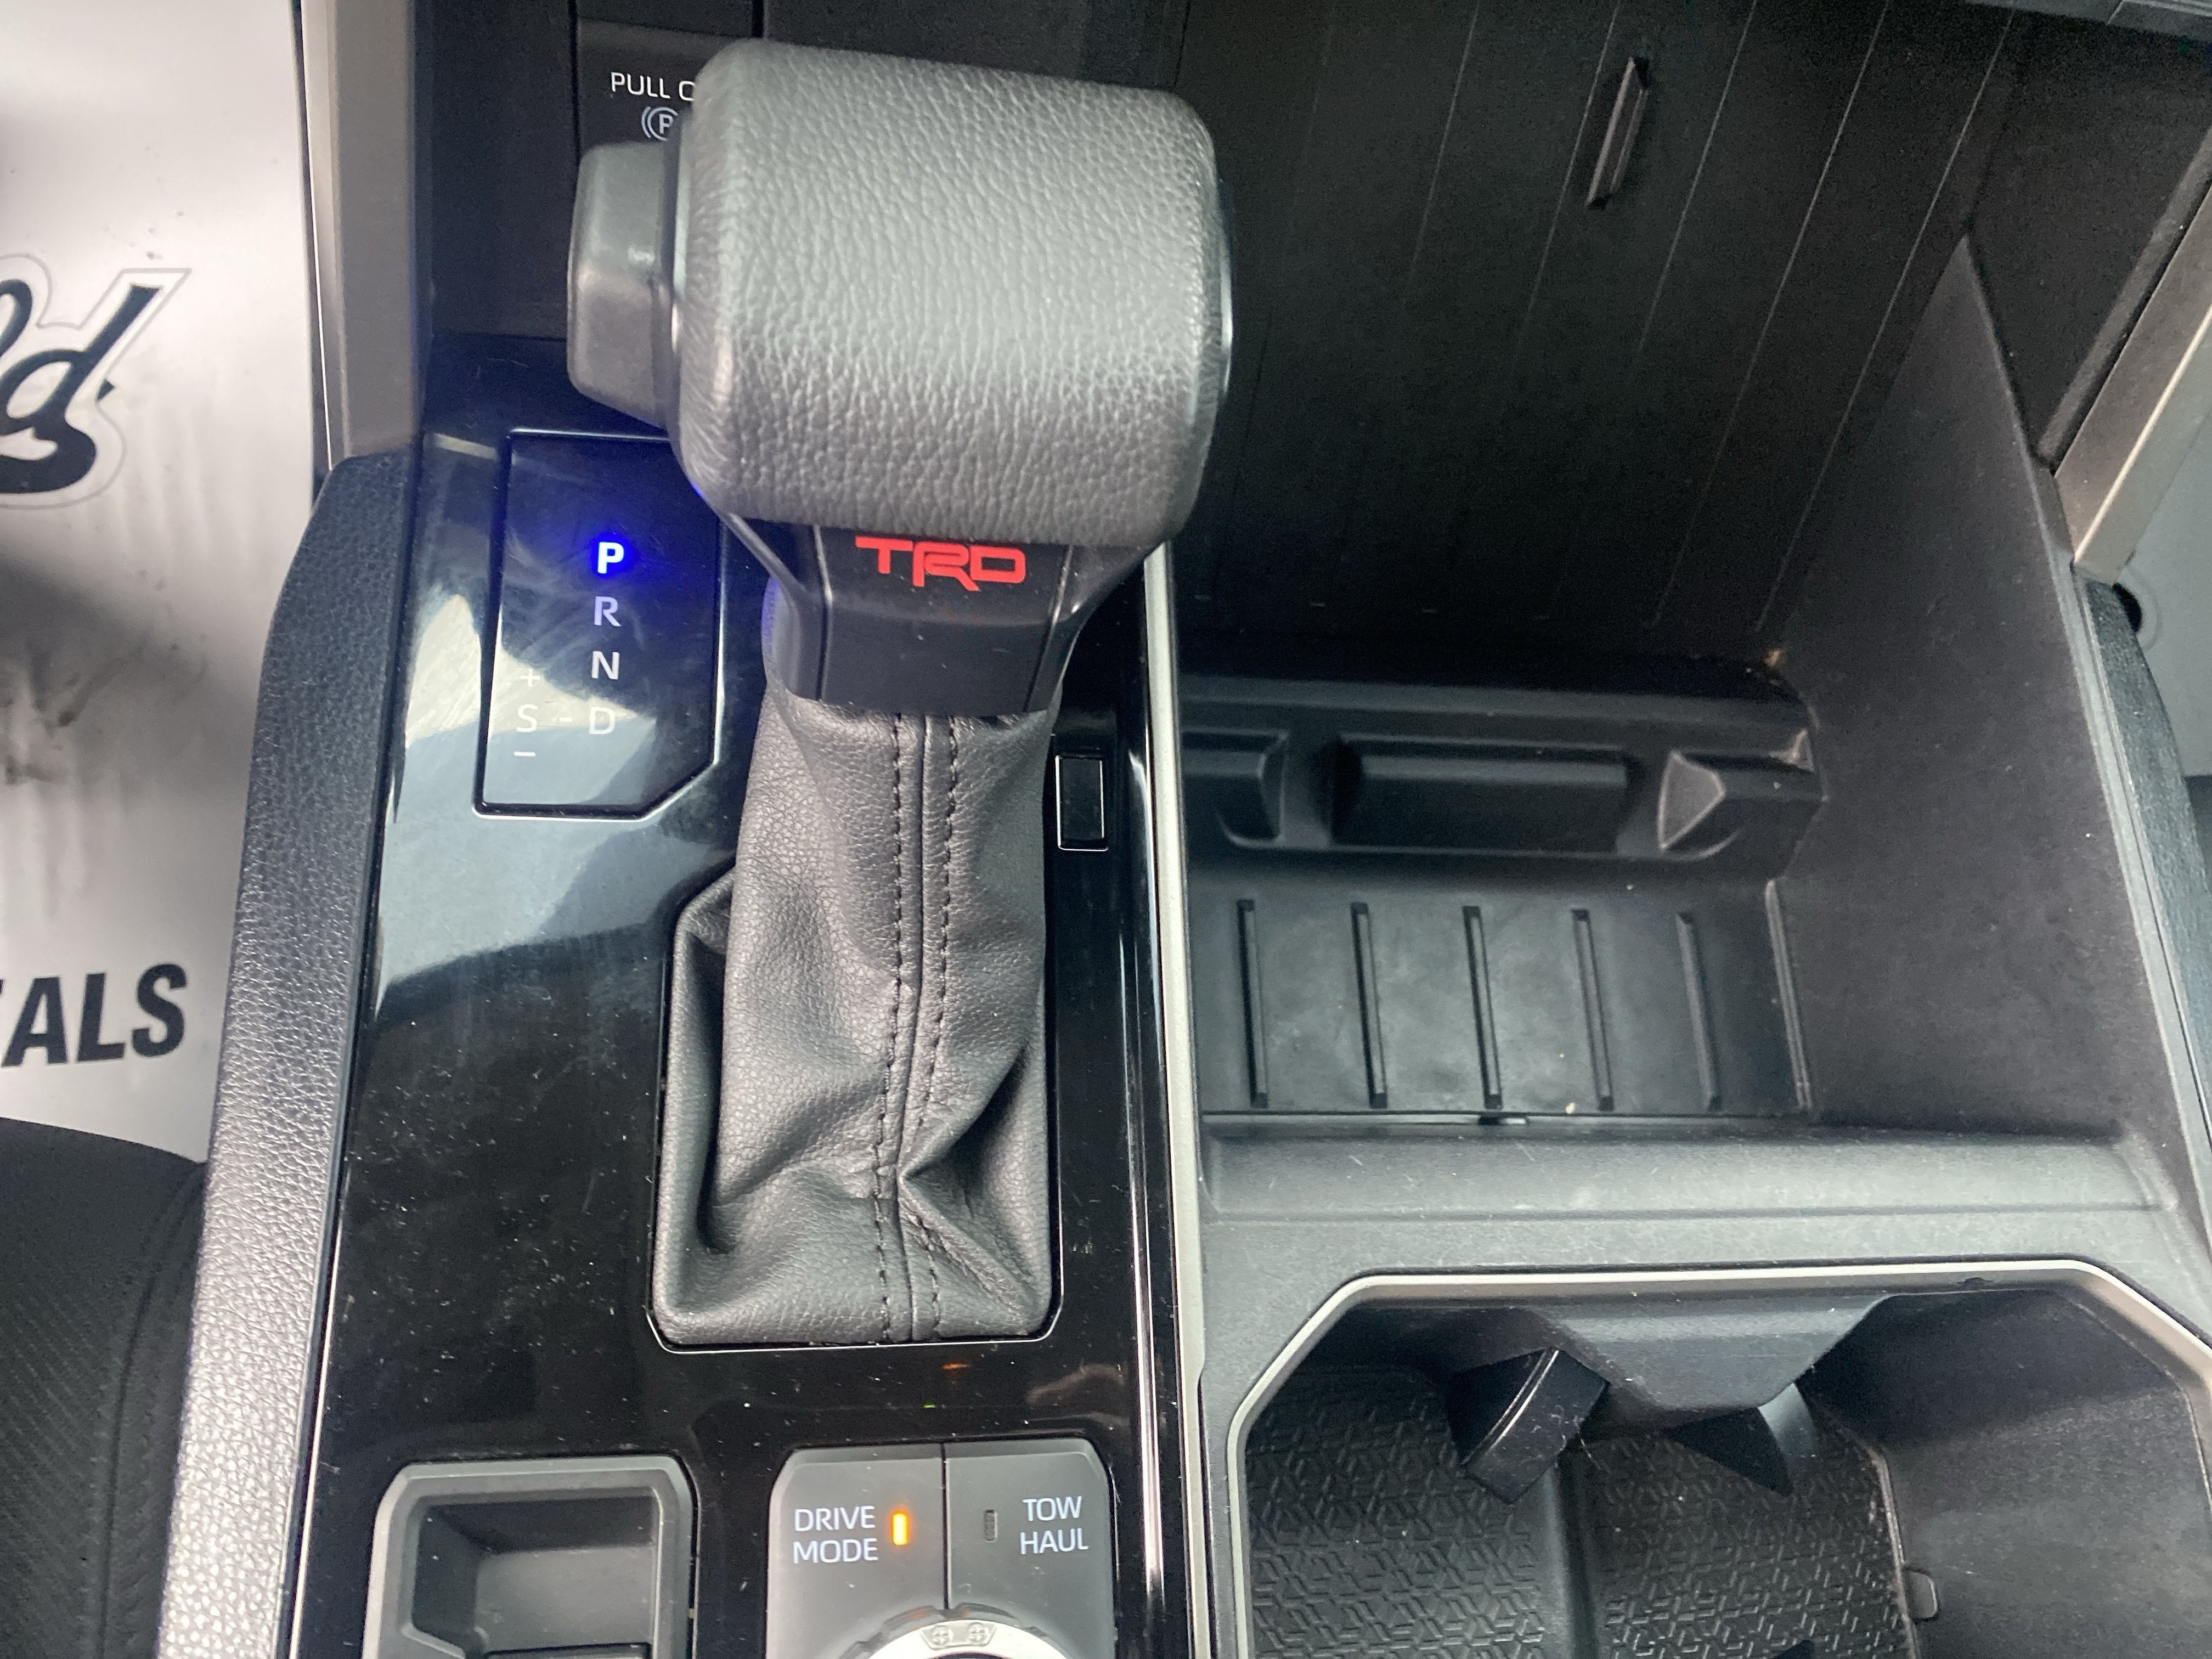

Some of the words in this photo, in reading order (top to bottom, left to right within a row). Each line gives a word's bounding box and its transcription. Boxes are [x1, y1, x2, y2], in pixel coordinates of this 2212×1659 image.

[611, 71, 670, 99] PULL
[597, 541, 625, 574] P
[855, 535, 1026, 591] TRD
[593, 596, 622, 627] R
[591, 651, 620, 680] N
[516, 703, 538, 733] S
[588, 706, 617, 735] D
[0, 963, 187, 1068] ALS
[793, 1505, 876, 1532] DRIVE
[1022, 1496, 1083, 1522] TOW
[792, 1538, 879, 1564] MODE
[1019, 1527, 1090, 1555] HAUL
